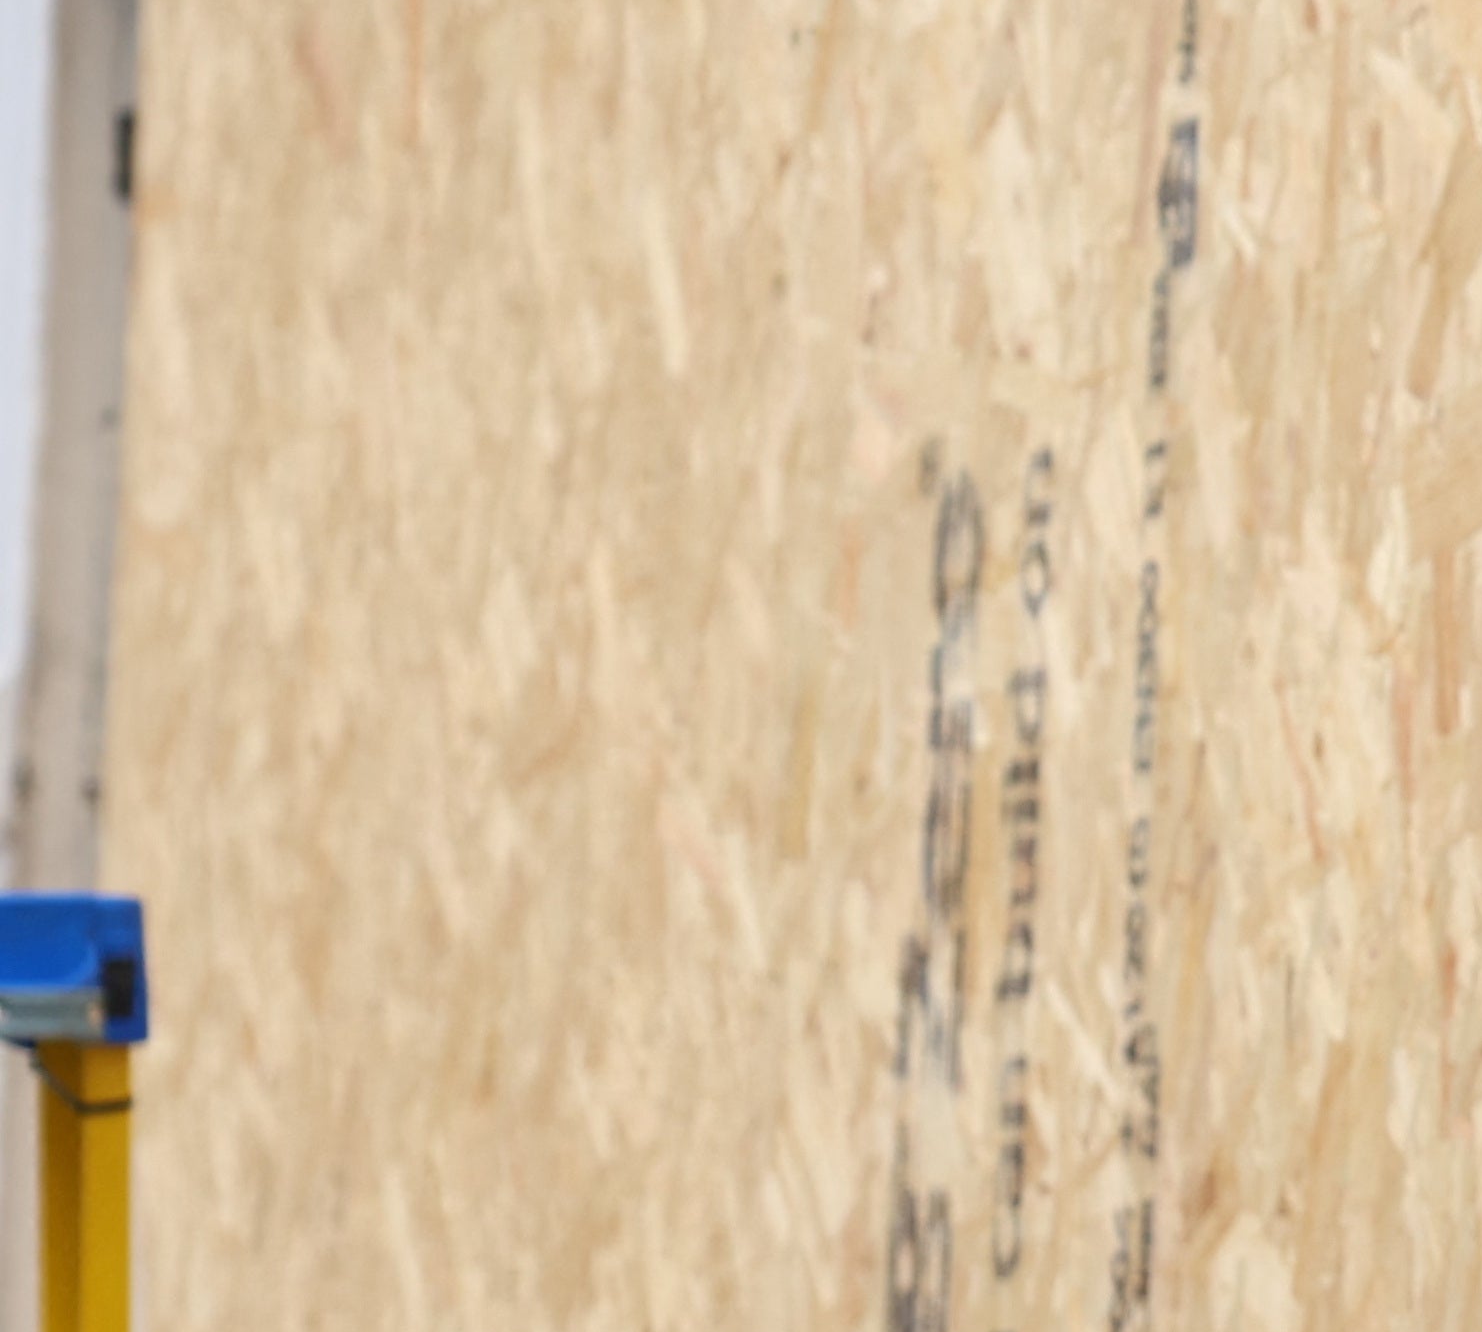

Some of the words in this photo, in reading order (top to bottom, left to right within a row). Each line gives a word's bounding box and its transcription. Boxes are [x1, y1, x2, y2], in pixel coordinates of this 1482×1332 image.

[1018, 445, 1054, 620] on
[997, 665, 1047, 1005] build
[986, 1055, 1029, 1279] can
